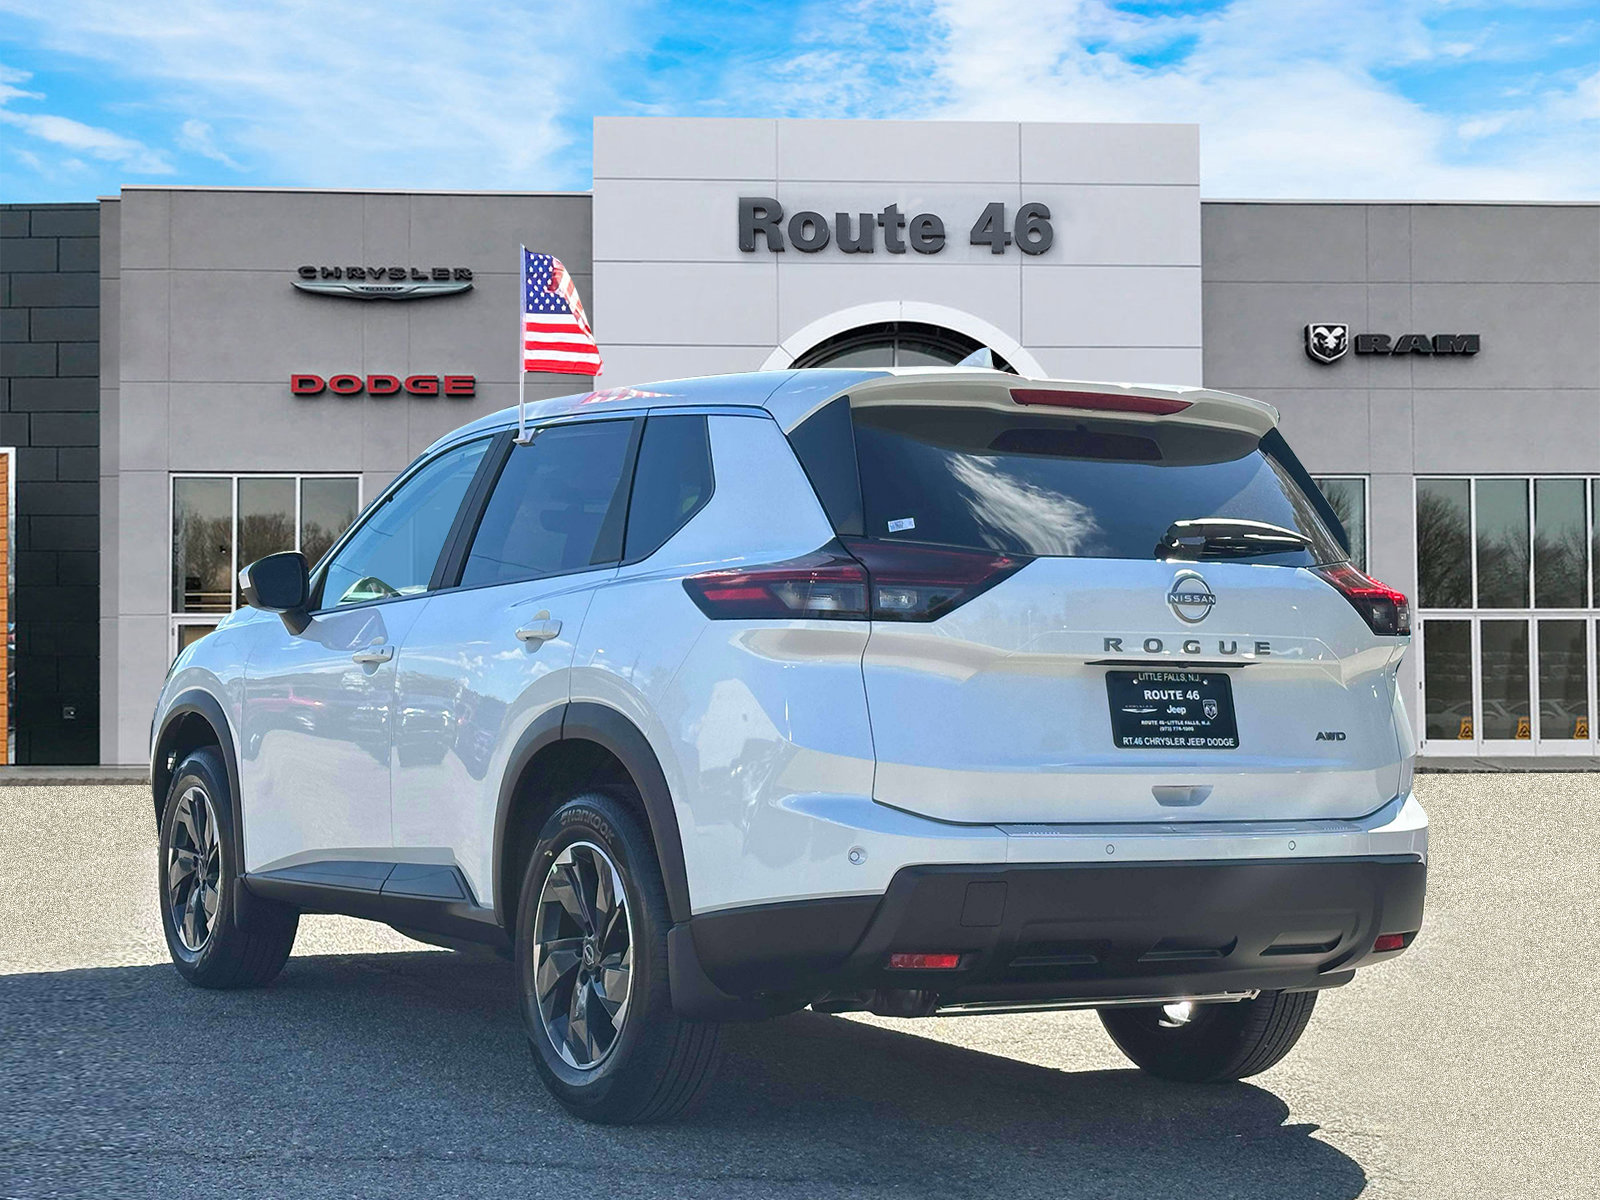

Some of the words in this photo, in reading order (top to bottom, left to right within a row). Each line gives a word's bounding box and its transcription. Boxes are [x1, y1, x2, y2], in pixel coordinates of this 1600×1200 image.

[738, 197, 946, 254] Route
[970, 202, 1054, 256] 46
[298, 266, 473, 281] CHRYSLER
[1354, 334, 1480, 355] RAM
[291, 374, 476, 396] DODGE
[1169, 594, 1216, 604] NISSAN
[1103, 637, 1271, 655] ROGUE
[1138, 672, 1162, 681] LITTLE
[1163, 673, 1188, 683] FALLS,
[1143, 690, 1184, 700] ROUTE
[1186, 690, 1200, 700] 46
[1166, 705, 1187, 715] Jeep
[1144, 736, 1186, 746] CHRYSLER
[1186, 737, 1206, 746] JEEP
[1206, 737, 1235, 747] DODGE
[1315, 731, 1347, 742] AWD
